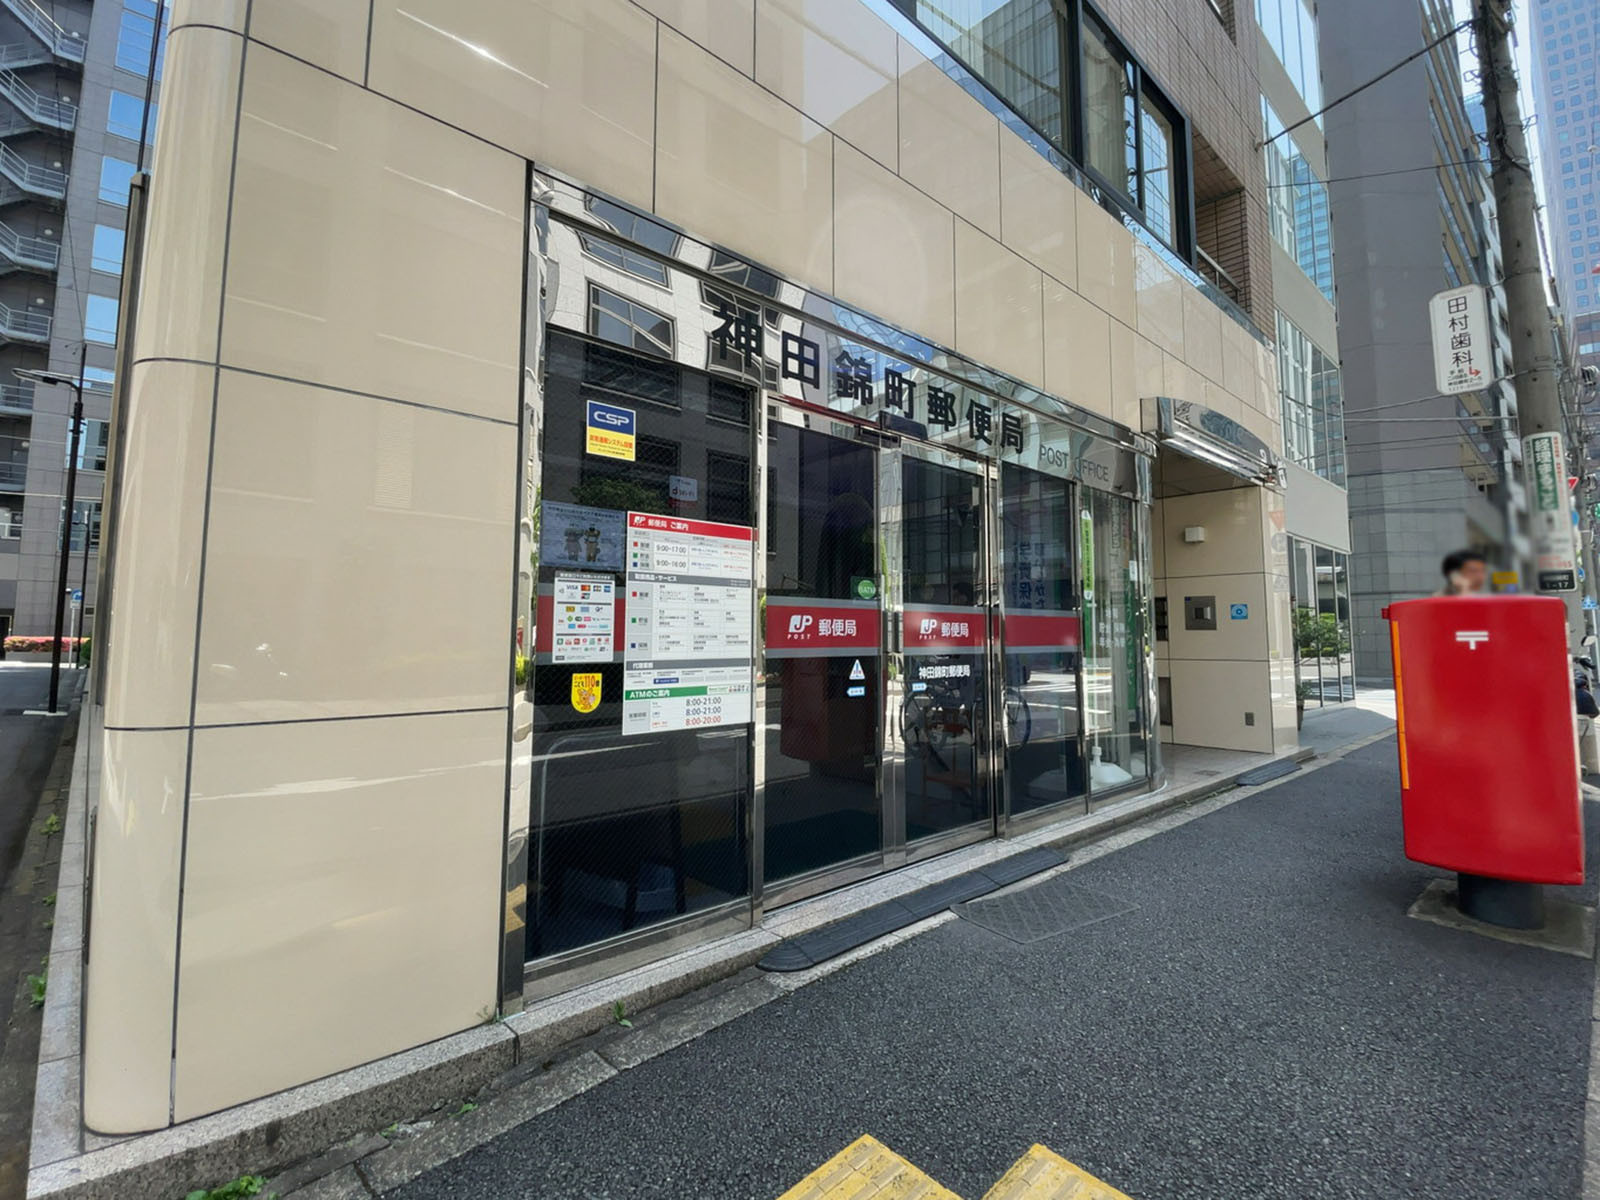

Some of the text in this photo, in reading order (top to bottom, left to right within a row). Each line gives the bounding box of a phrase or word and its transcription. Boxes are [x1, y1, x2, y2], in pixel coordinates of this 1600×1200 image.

[1448, 296, 1473, 368] 田村歯科
[712, 307, 1025, 455] 神田錦町郵便局
[594, 411, 630, 426] CSP
[1040, 444, 1110, 482] POST OFFICE
[648, 519, 667, 528] 郵便局
[670, 521, 689, 531] ご案内
[818, 618, 857, 637] 郵便局
[941, 621, 969, 638] 郵便局
[919, 664, 971, 679] 神田錦町郵便局
[630, 690, 671, 699] ATMのご案内
